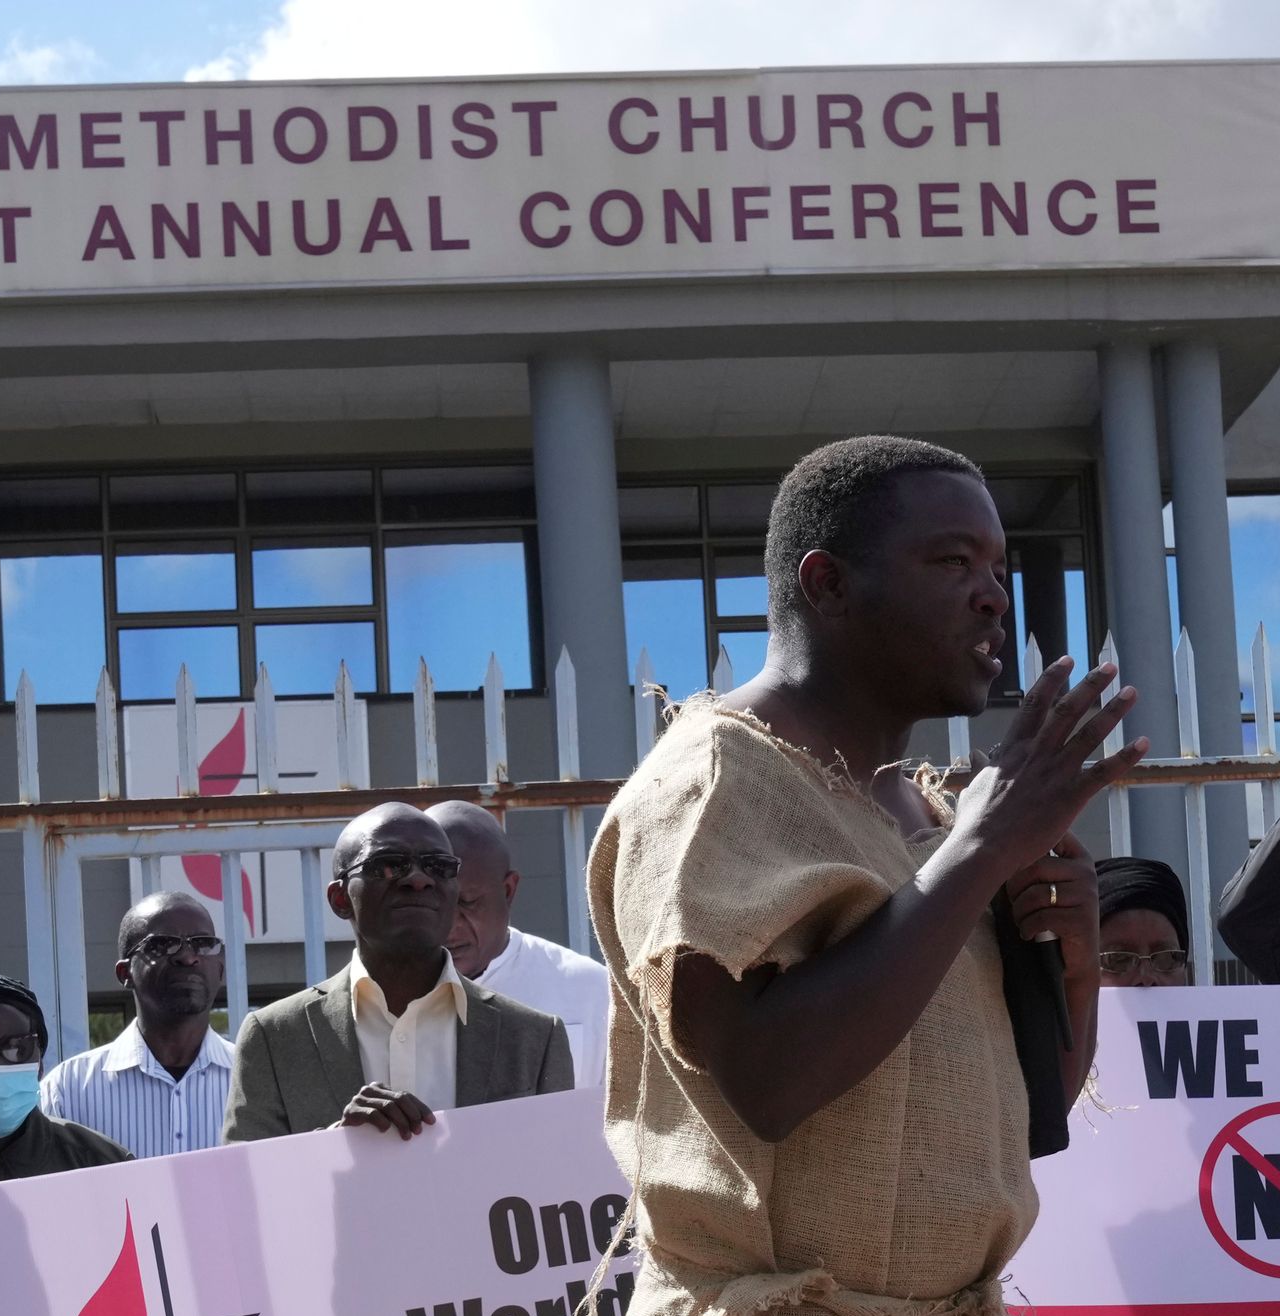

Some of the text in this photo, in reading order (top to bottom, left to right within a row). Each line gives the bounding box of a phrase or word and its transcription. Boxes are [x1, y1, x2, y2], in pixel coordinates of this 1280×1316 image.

[608, 92, 1003, 156] CHURCH
[81, 196, 471, 262] ANNUAL
[520, 179, 1160, 249] CONFERENCE
[1136, 1018, 1264, 1100] WE
[488, 1193, 635, 1275] One
